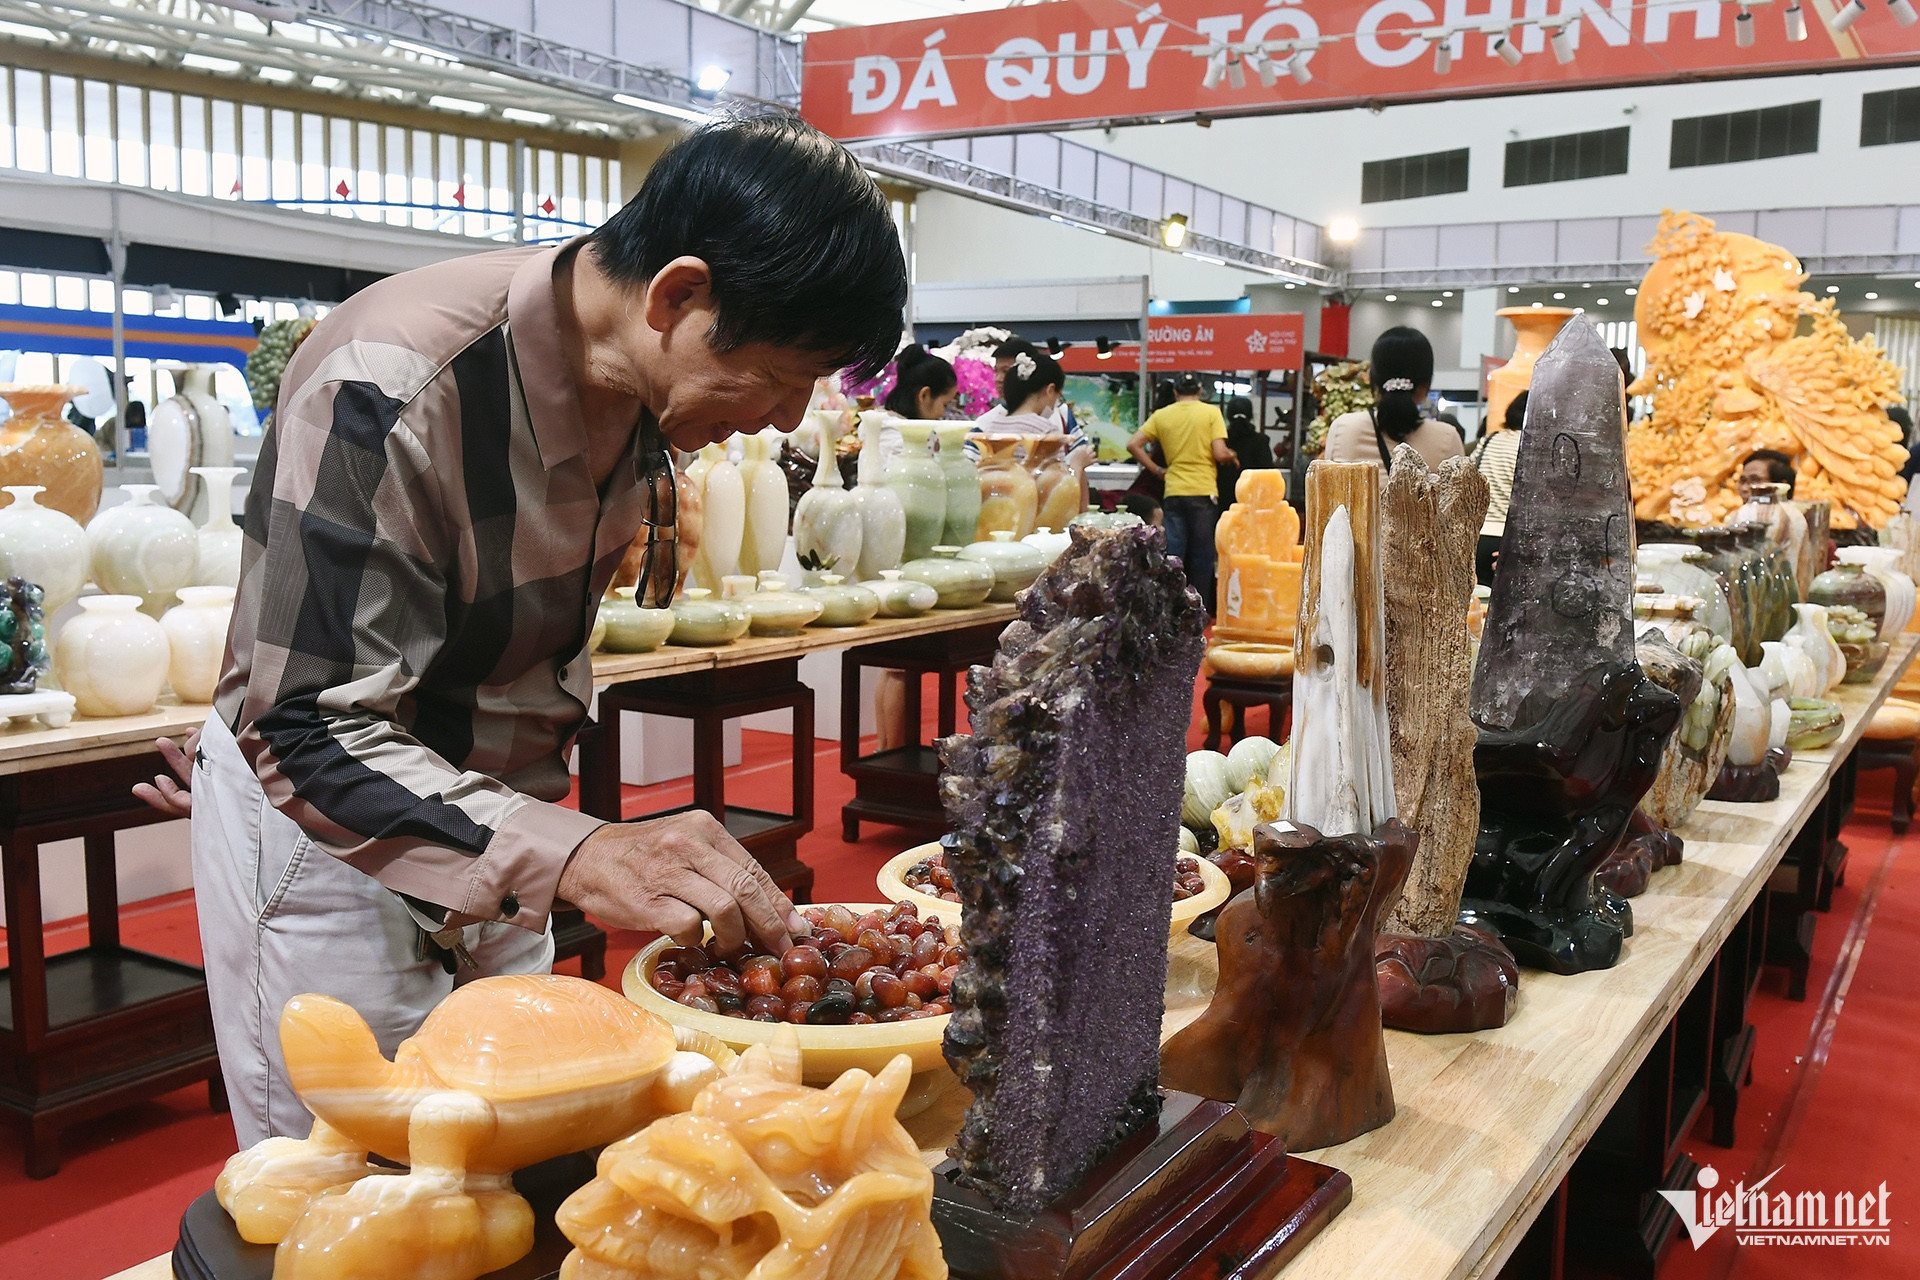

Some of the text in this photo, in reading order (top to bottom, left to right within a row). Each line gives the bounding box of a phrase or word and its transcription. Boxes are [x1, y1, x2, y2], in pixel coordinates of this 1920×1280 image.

[847, 27, 958, 115] ĐÁ
[984, 2, 1168, 101] QUÝ
[1147, 324, 1193, 343] RƯỜNG
